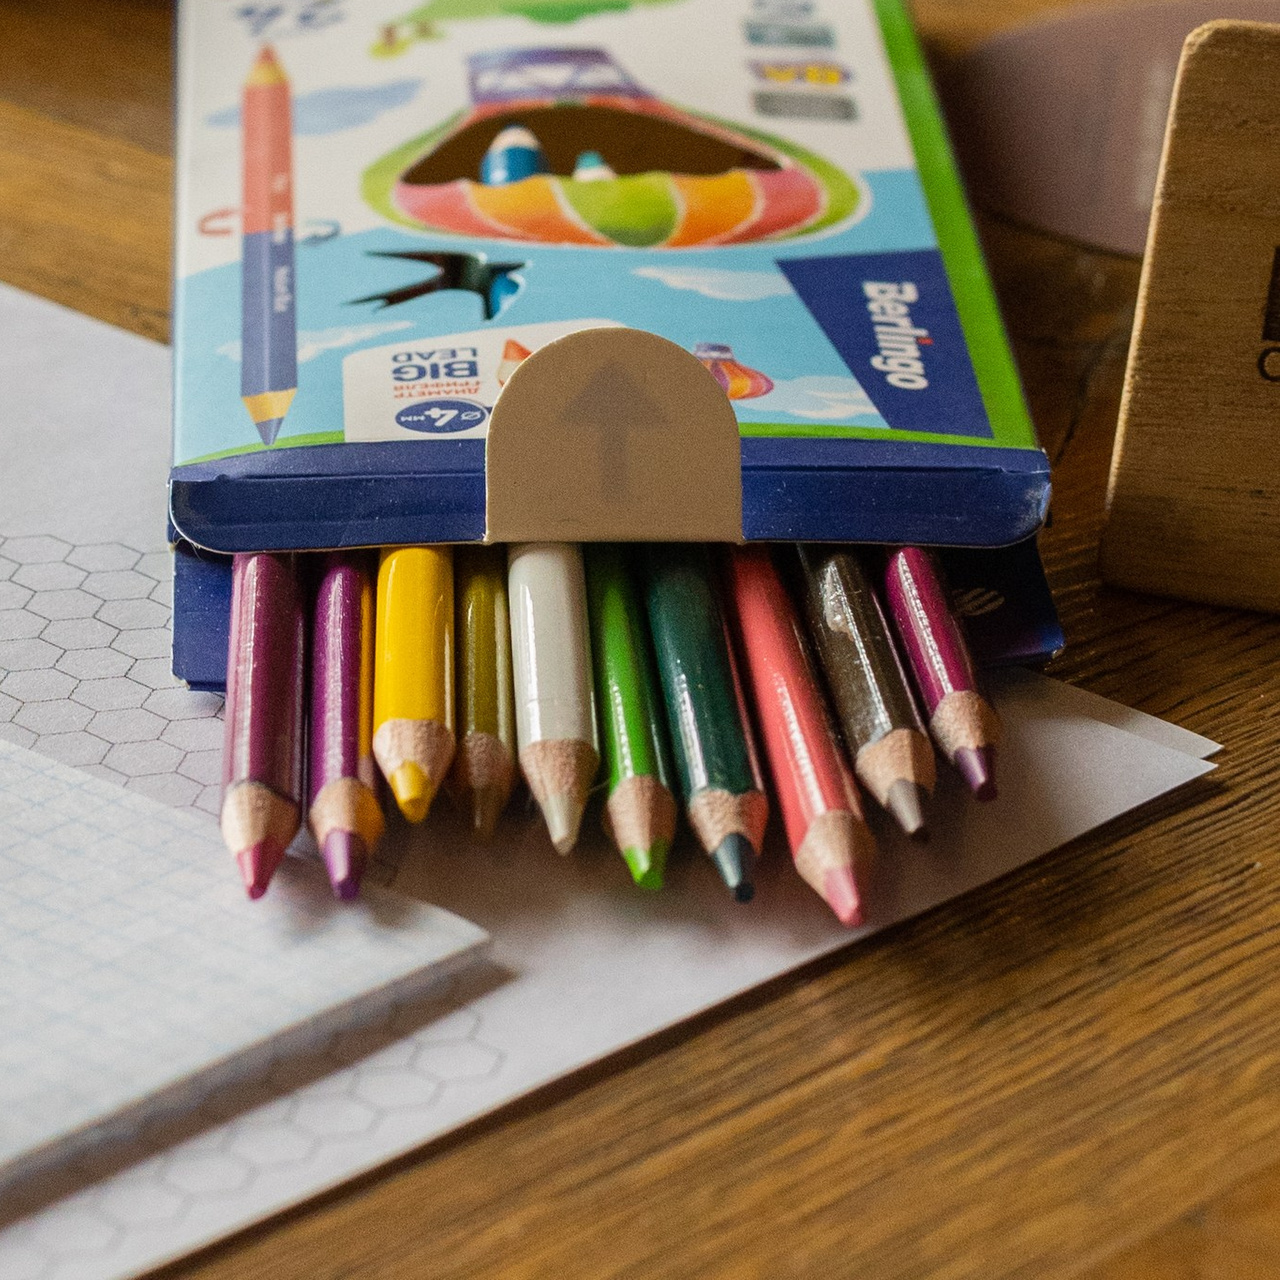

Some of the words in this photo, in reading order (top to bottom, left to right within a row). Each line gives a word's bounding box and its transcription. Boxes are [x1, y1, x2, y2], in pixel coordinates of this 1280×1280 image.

[863, 281, 933, 390] Berlingo
[393, 348, 478, 362] LEAD
[392, 360, 478, 382] BIG
[394, 388, 479, 398] ДИАМЕТР
